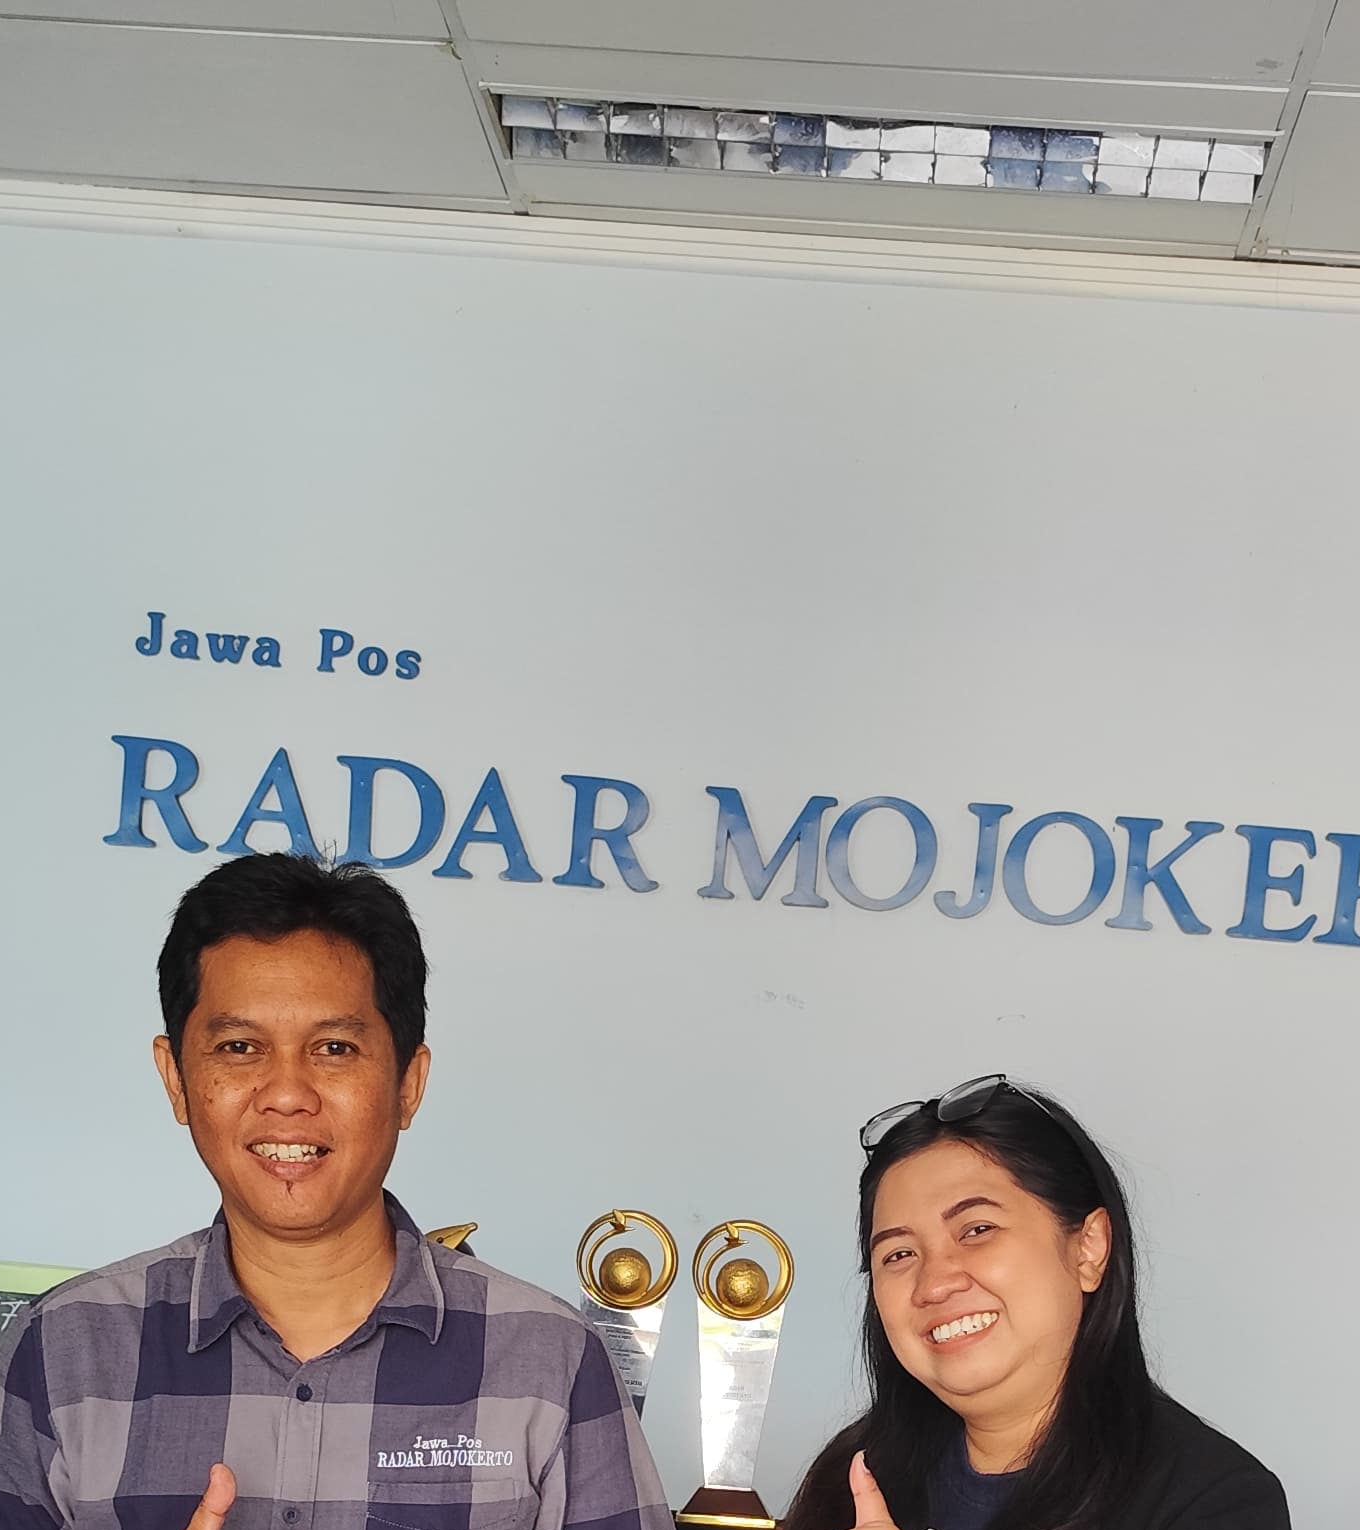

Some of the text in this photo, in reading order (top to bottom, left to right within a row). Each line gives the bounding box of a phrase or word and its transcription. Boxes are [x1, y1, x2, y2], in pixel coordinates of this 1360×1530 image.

[136, 612, 424, 681] Jawa Pos
[104, 733, 660, 893] RADAR
[377, 1450, 512, 1467] RADAR MOJOKERTO
[413, 1435, 482, 1449] Jawa Pos
